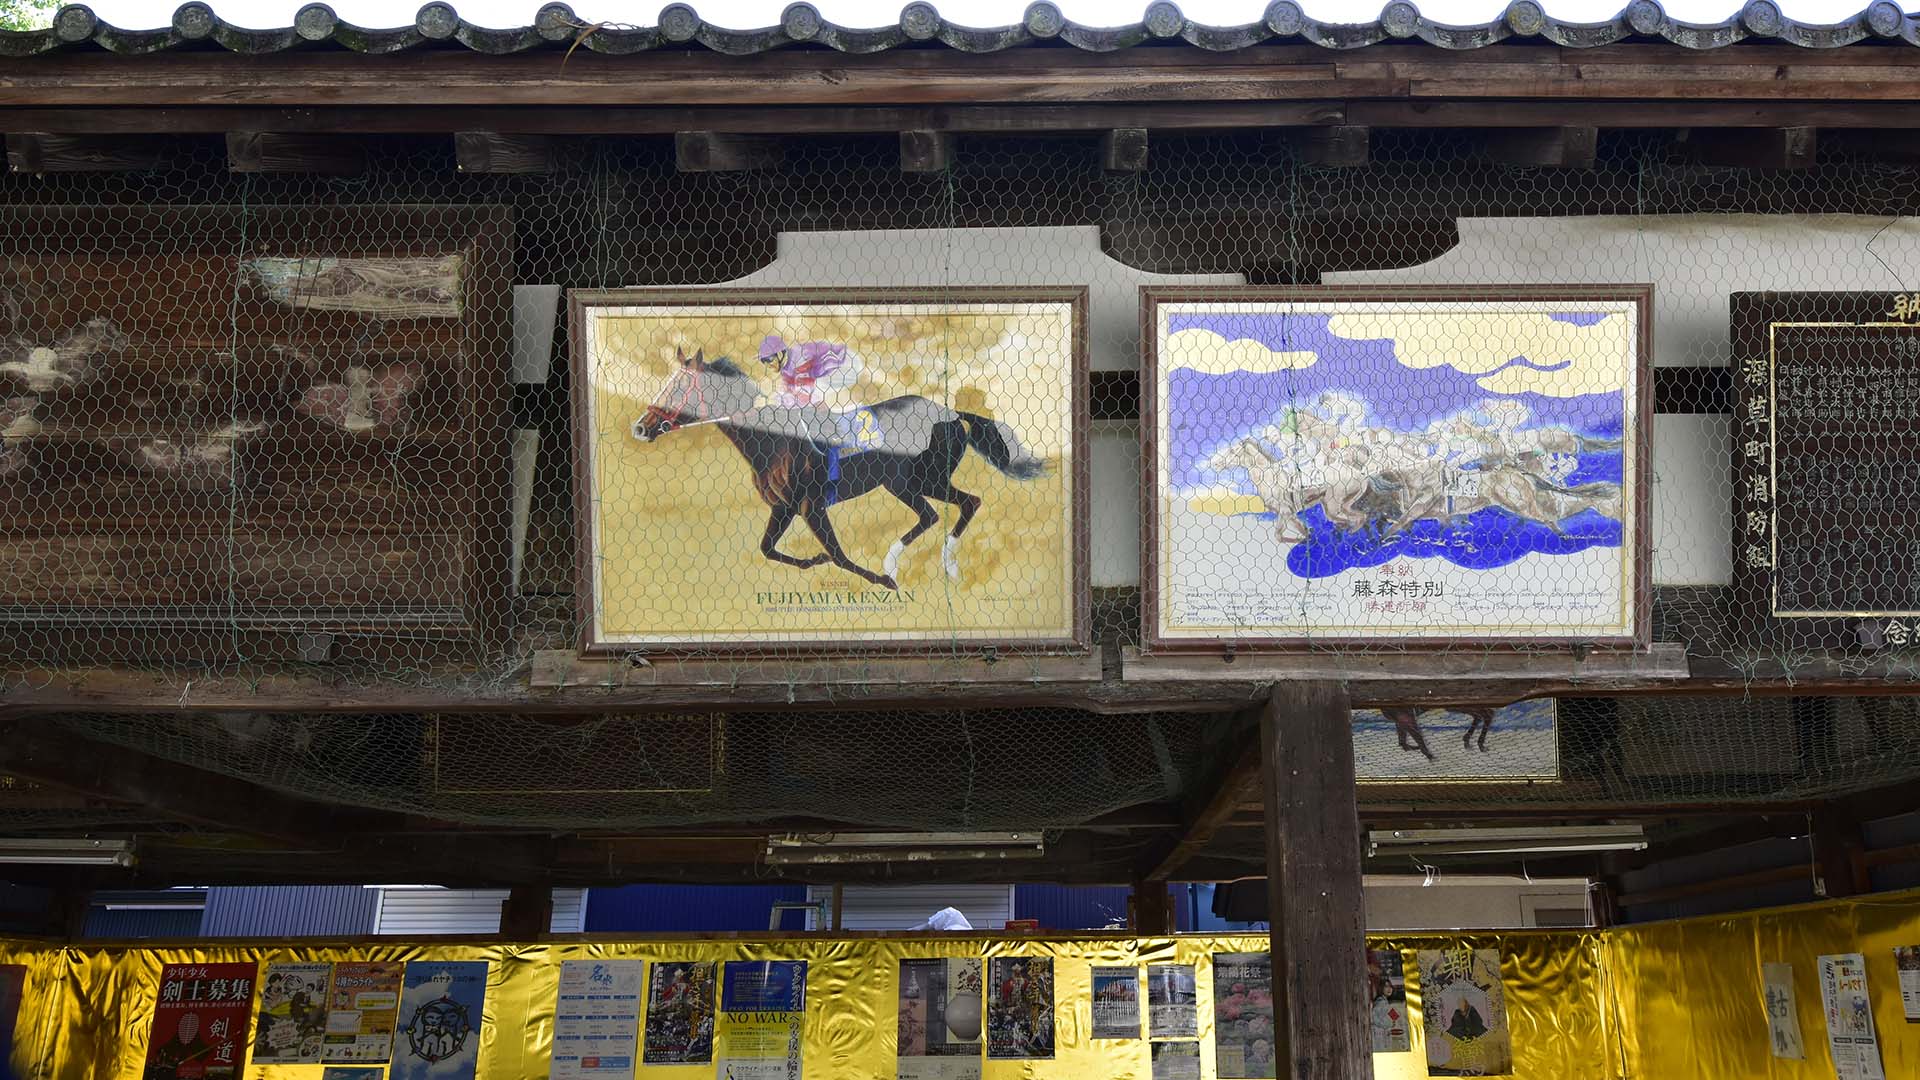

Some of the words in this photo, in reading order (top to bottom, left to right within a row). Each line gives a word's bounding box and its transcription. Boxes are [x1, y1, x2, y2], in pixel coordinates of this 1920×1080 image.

[856, 410, 880, 443] 2
[1744, 358, 1771, 569] 深草町消防組
[756, 591, 844, 605] FUJIYAMA
[847, 590, 916, 604] KENZAN
[1351, 579, 1443, 598] 藤森特別
[1882, 619, 1920, 644] 念
[167, 967, 209, 979] 少年少女
[162, 979, 251, 1002] 剣士募集
[726, 1012, 749, 1024] NO
[755, 1012, 788, 1024] WAR
[786, 964, 802, 1080] ウクライナへの支援の輪を
[209, 1016, 233, 1063] 剣道
